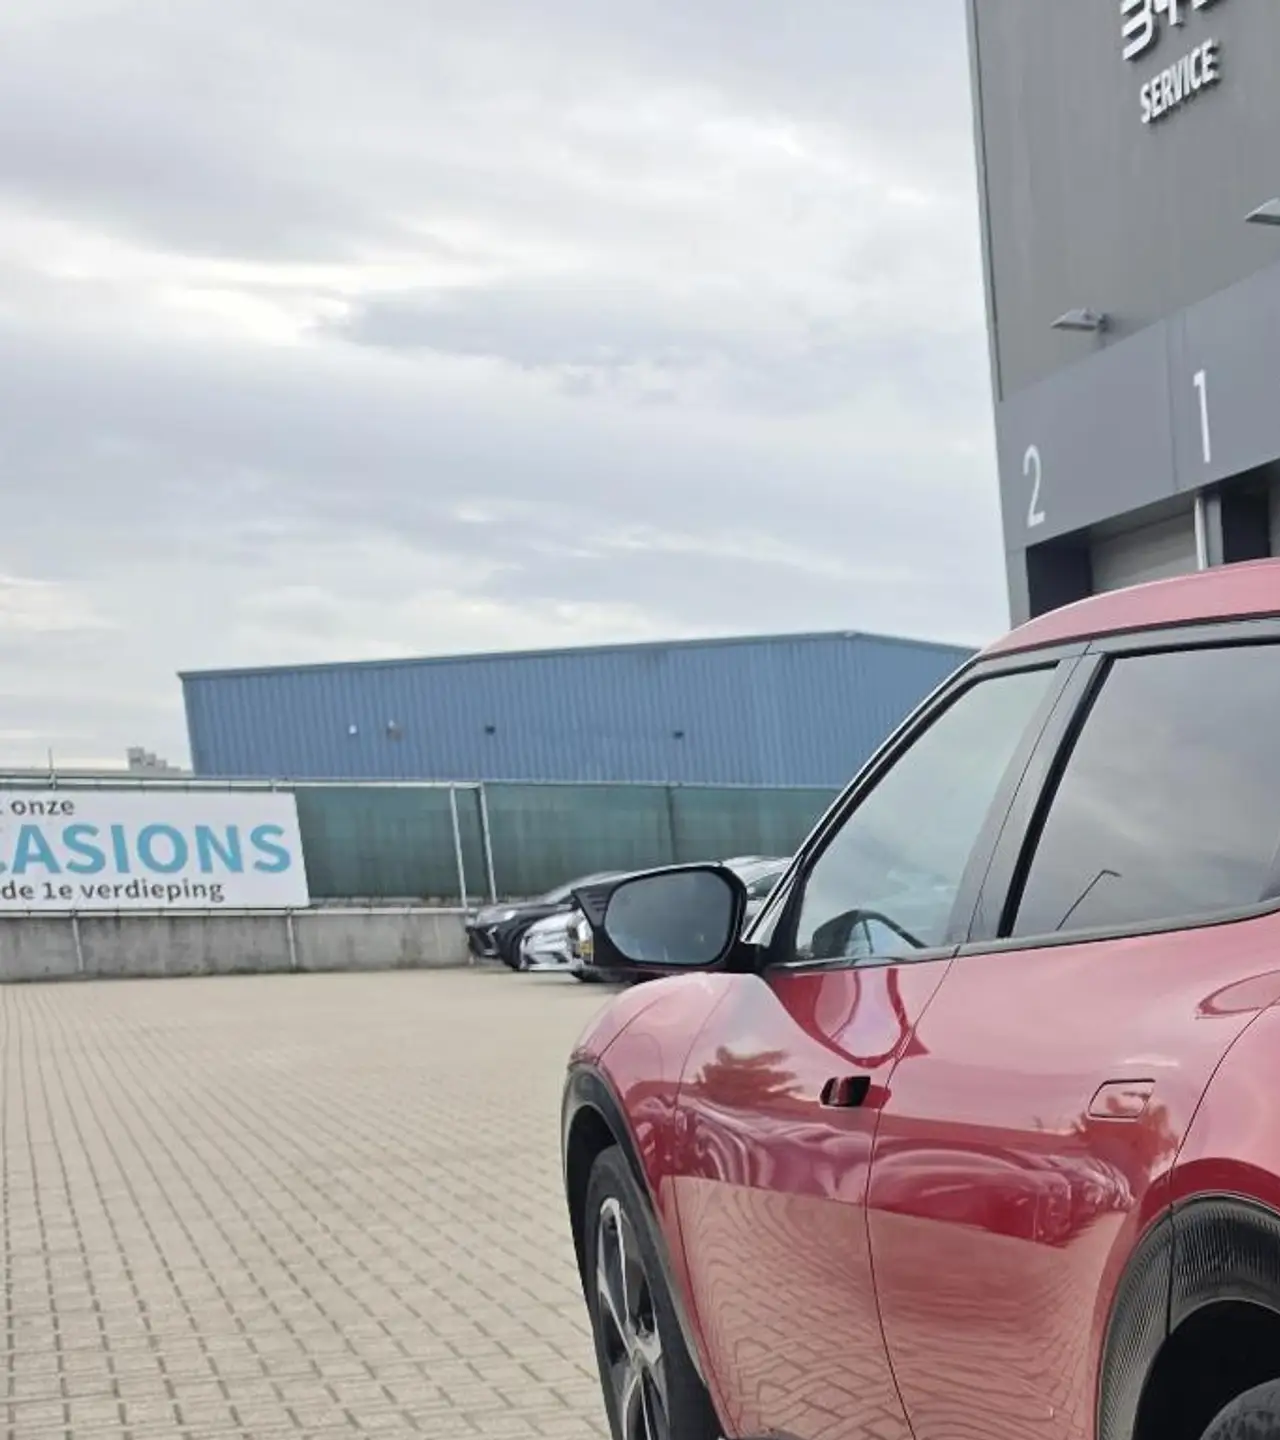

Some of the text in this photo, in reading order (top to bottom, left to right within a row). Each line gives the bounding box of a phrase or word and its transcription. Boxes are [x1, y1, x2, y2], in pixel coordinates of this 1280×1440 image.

[1140, 38, 1218, 124] SERVICE
[1193, 369, 1211, 464] 1
[1023, 444, 1046, 528] 2
[10, 799, 76, 816] onze
[0, 823, 292, 876] ASIONS
[1, 878, 226, 903] de 1e verdieping
